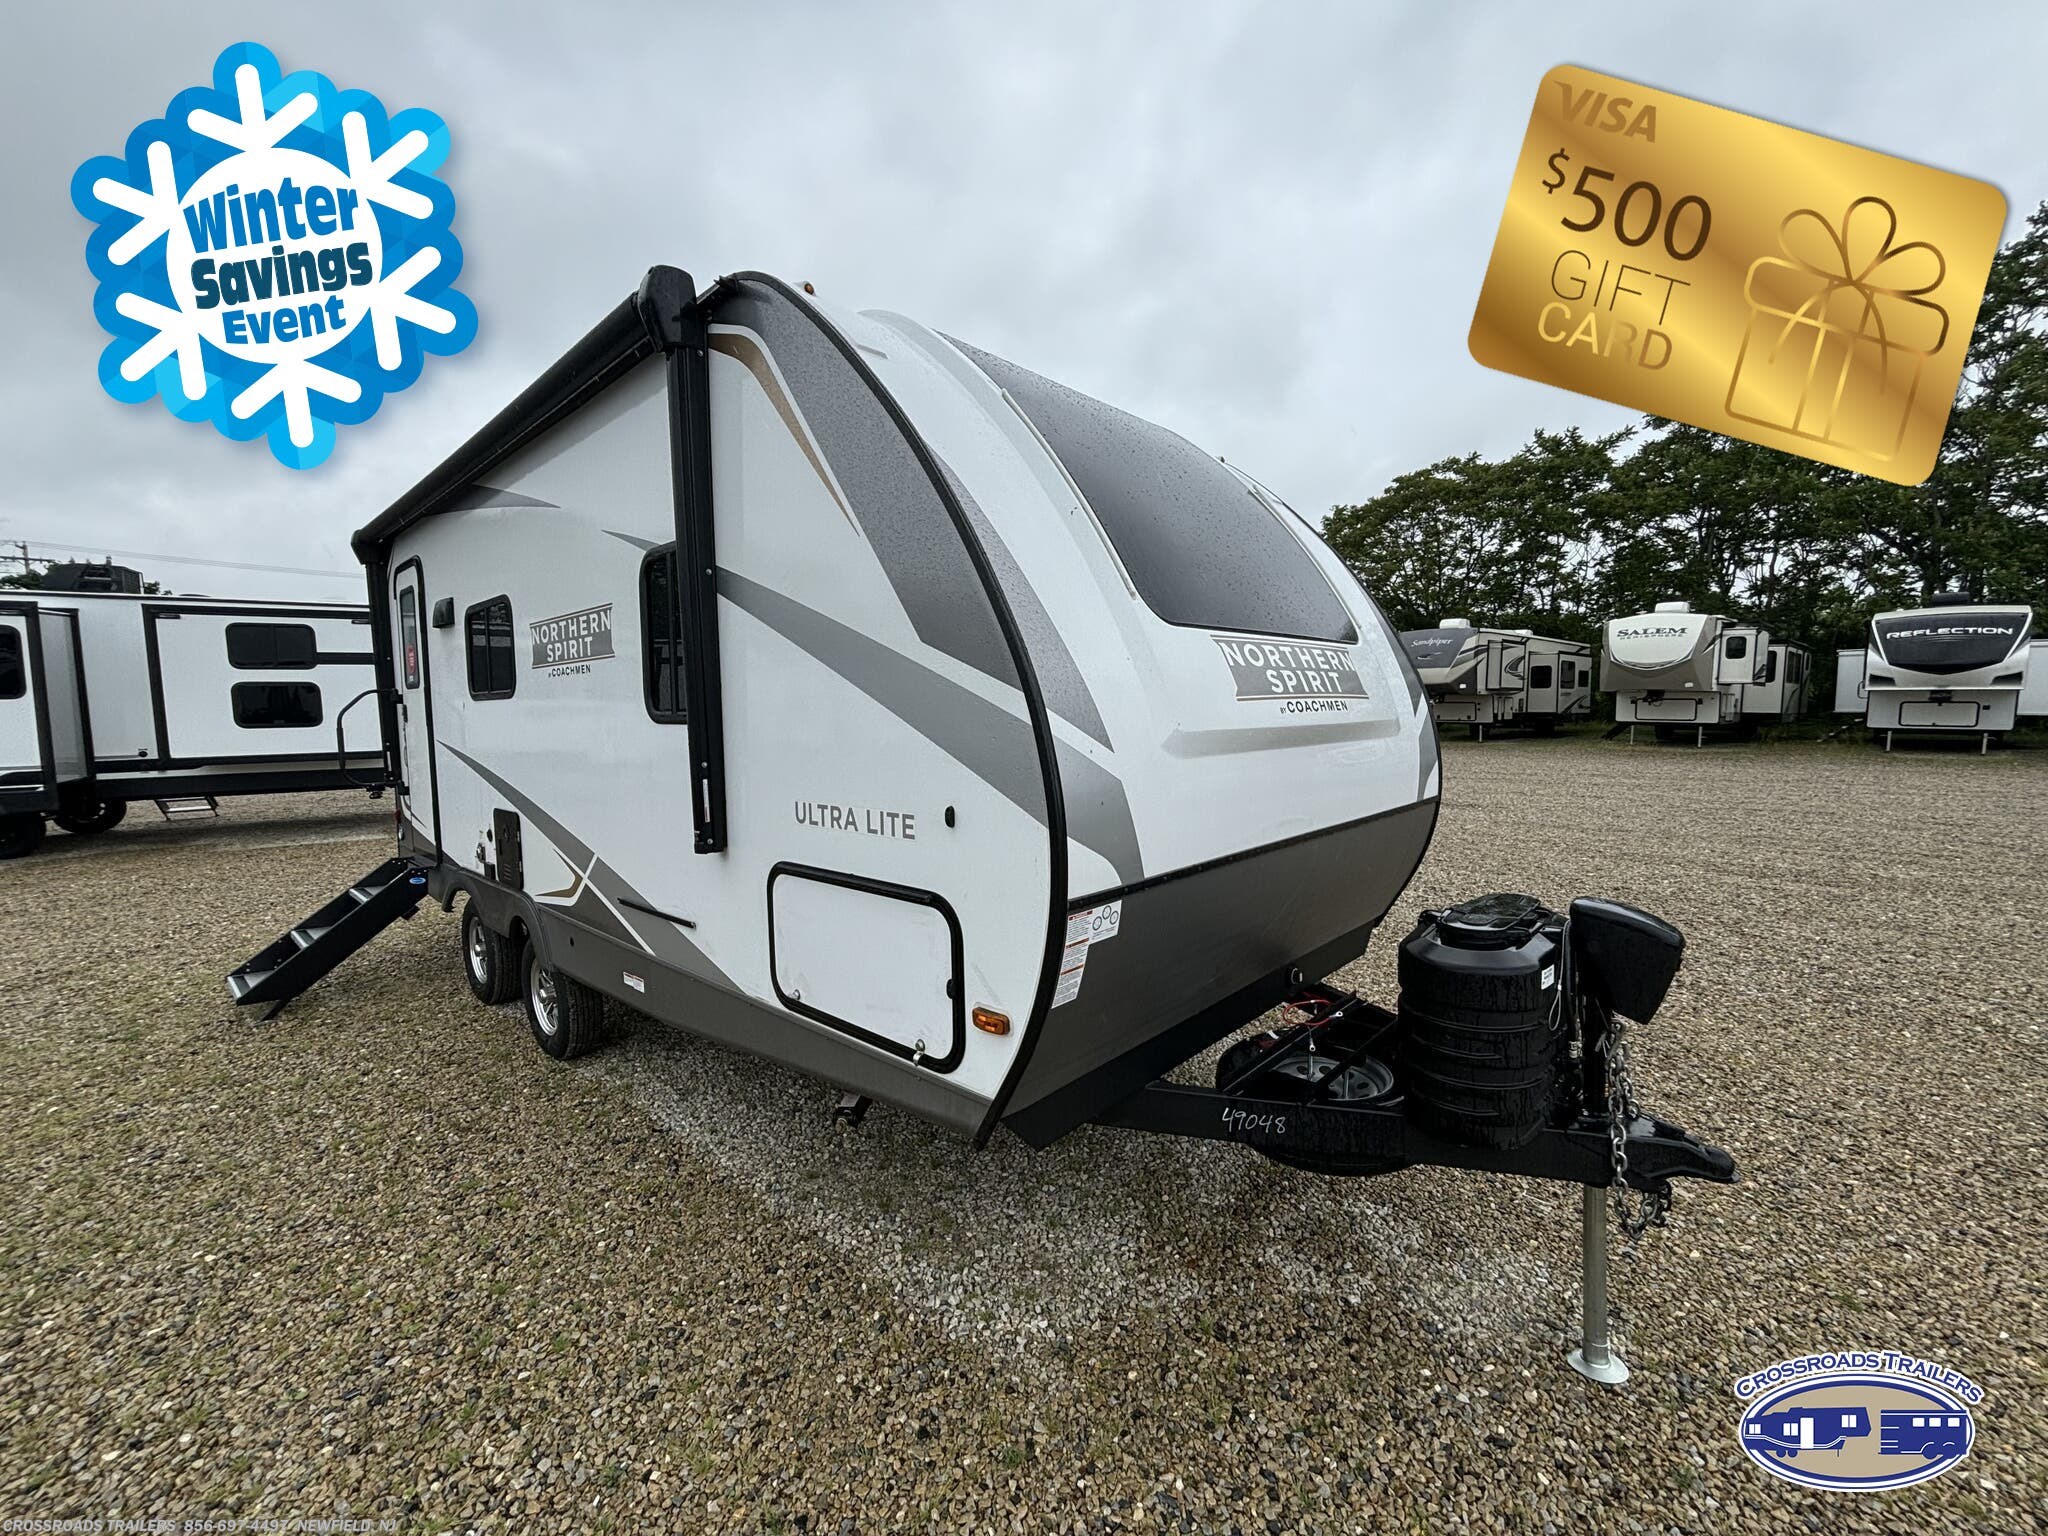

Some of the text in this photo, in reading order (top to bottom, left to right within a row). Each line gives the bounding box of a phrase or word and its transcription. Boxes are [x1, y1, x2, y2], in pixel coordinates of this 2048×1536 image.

[531, 609, 611, 645] NORTHERN
[1617, 627, 1688, 637] SALEM
[1886, 627, 2014, 639] REFLECTION
[546, 636, 593, 662] SPIRIT
[1218, 642, 1355, 671] NORTHERN
[551, 664, 591, 677] COACHMEN
[1266, 669, 1342, 693] SPIRIT
[1286, 701, 1348, 713] COACHMEN
[795, 801, 915, 840] ULTRA LITE
[1222, 1107, 1286, 1134] 49048
